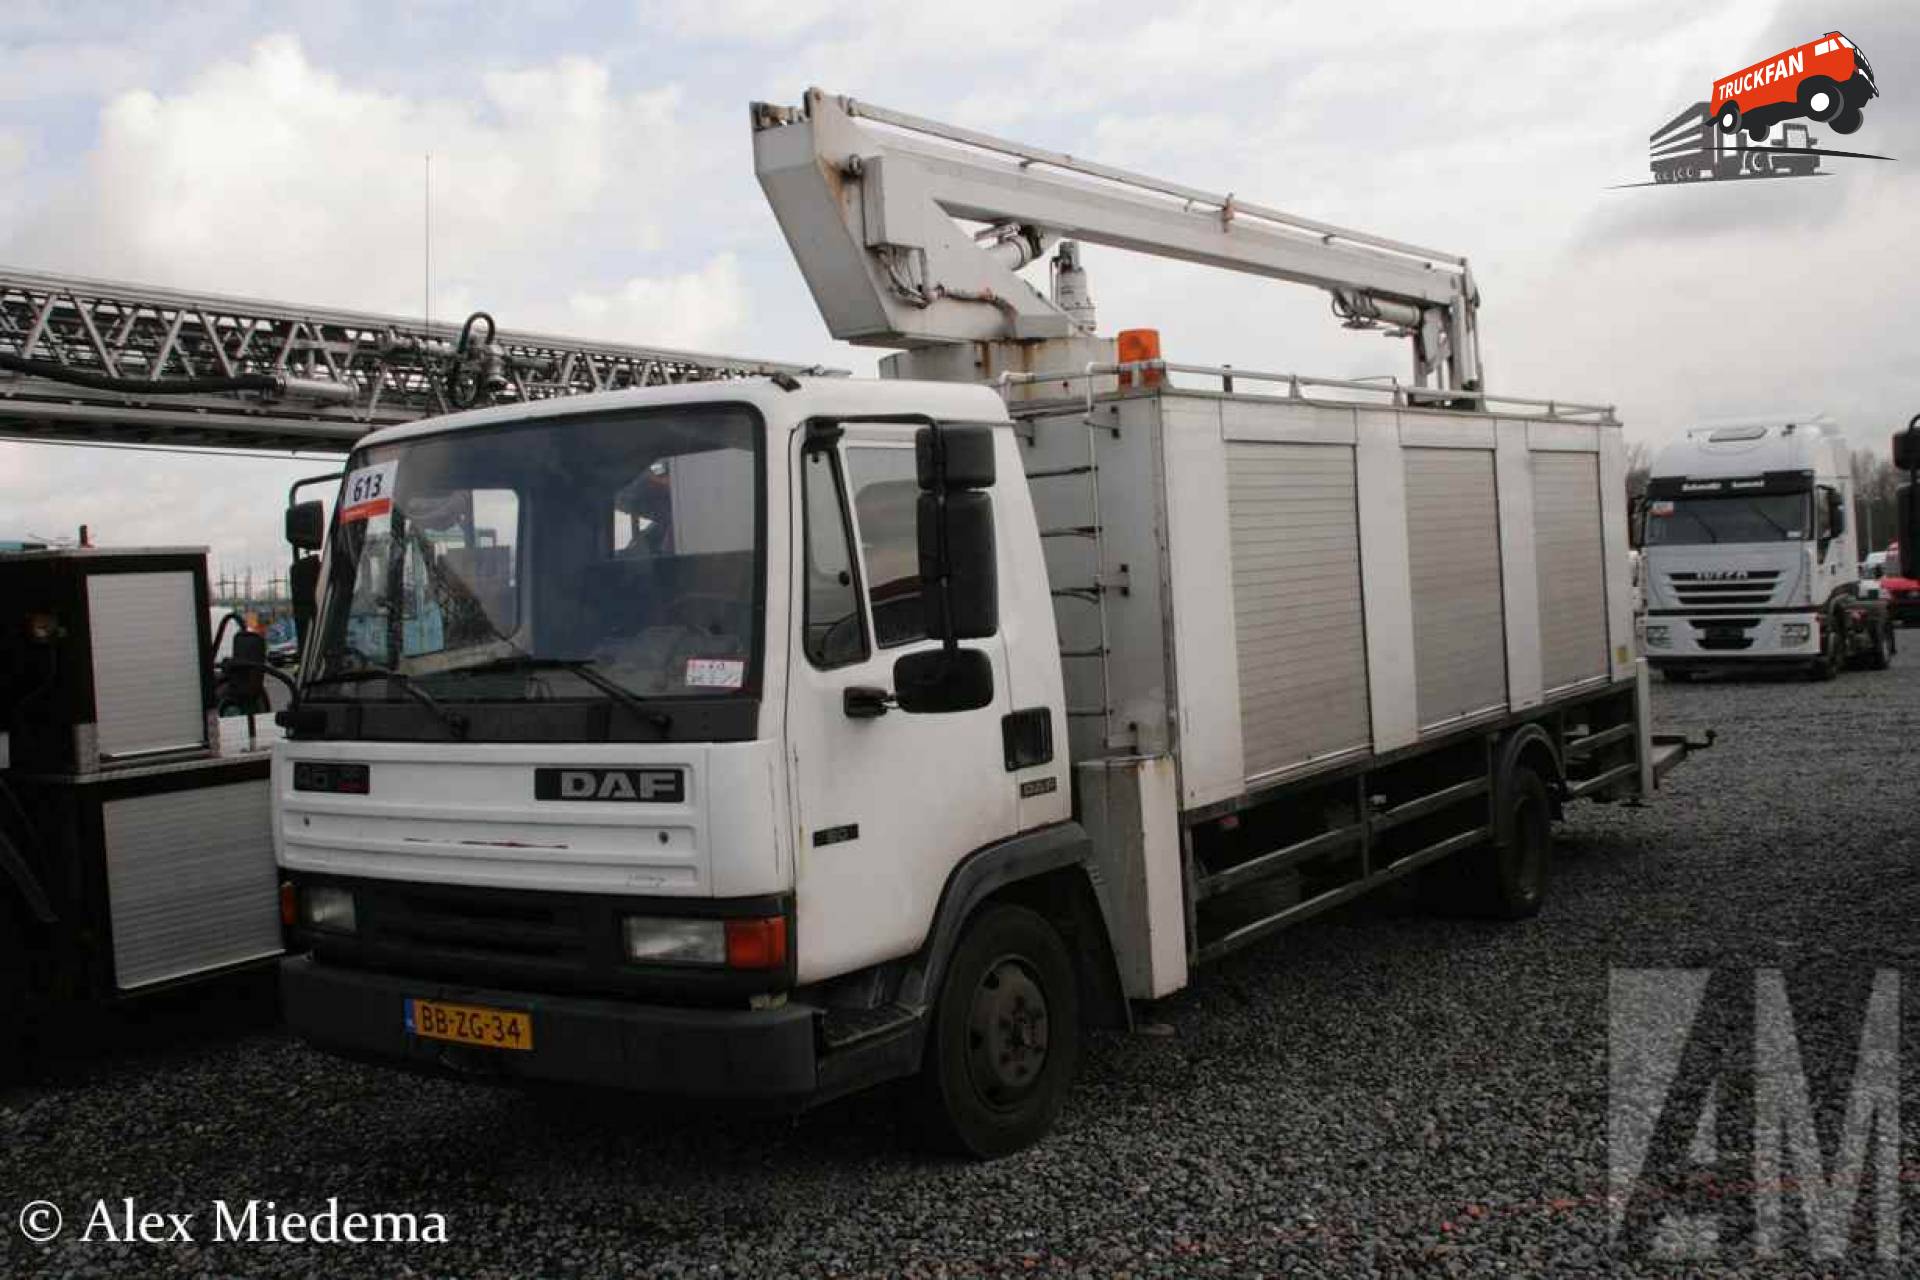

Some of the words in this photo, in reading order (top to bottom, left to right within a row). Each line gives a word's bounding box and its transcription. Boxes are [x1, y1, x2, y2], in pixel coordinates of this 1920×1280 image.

[353, 473, 384, 502] 613
[561, 771, 676, 799] DAF
[422, 1005, 521, 1048] BB-ZG-34
